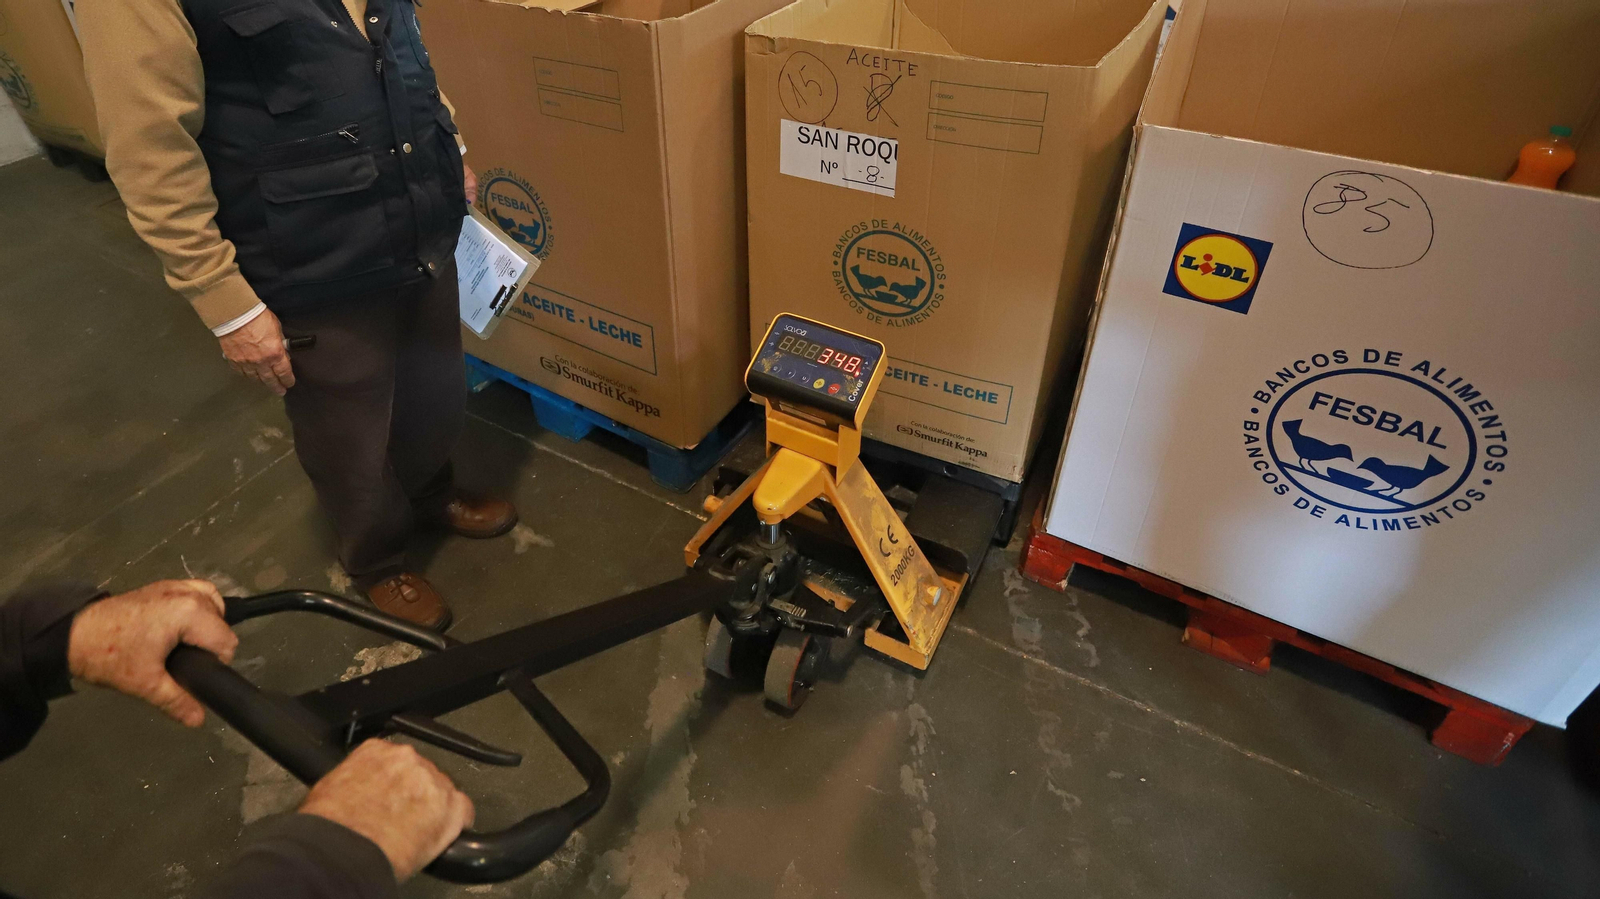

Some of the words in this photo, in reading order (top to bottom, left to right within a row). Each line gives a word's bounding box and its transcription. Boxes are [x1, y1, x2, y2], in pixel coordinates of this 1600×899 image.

[846, 48, 919, 77] ACEITE
[797, 125, 839, 150] SAN
[846, 135, 898, 164] ROQ
[491, 192, 534, 215] FESBAL
[494, 168, 506, 177] DE
[508, 170, 552, 223] ALIMENTOS
[832, 221, 869, 259] BANCOS
[871, 219, 889, 229] DE
[892, 222, 947, 281] ALIMENTOS
[856, 246, 921, 272] FESBAL
[523, 291, 576, 323] ACEITE
[588, 316, 643, 349] LECHE
[832, 270, 865, 315] BANCOS
[866, 312, 882, 325] DE
[886, 293, 945, 329] ALIMENTOS
[554, 353, 570, 367] Con
[570, 359, 578, 370] la
[578, 366, 625, 388] colaboración
[848, 379, 864, 402] Cover
[884, 365, 929, 387] CEITE
[943, 381, 999, 405] LECHE
[562, 366, 614, 399] Smurfit
[616, 387, 661, 418] Kappa
[1252, 349, 1349, 405] BANCOS
[1363, 348, 1403, 367] DE
[1410, 359, 1508, 473] ALIMENTOS
[910, 420, 922, 428] Con
[928, 426, 965, 441] colaboración
[1308, 390, 1448, 450] FESBAL
[914, 429, 954, 448] Smurfit
[955, 441, 988, 458] Kappa
[1243, 420, 1290, 496] BANCOS
[1293, 496, 1327, 519] DE
[1334, 488, 1486, 531] ALIMENTOS
[890, 545, 915, 587] 2000KG
